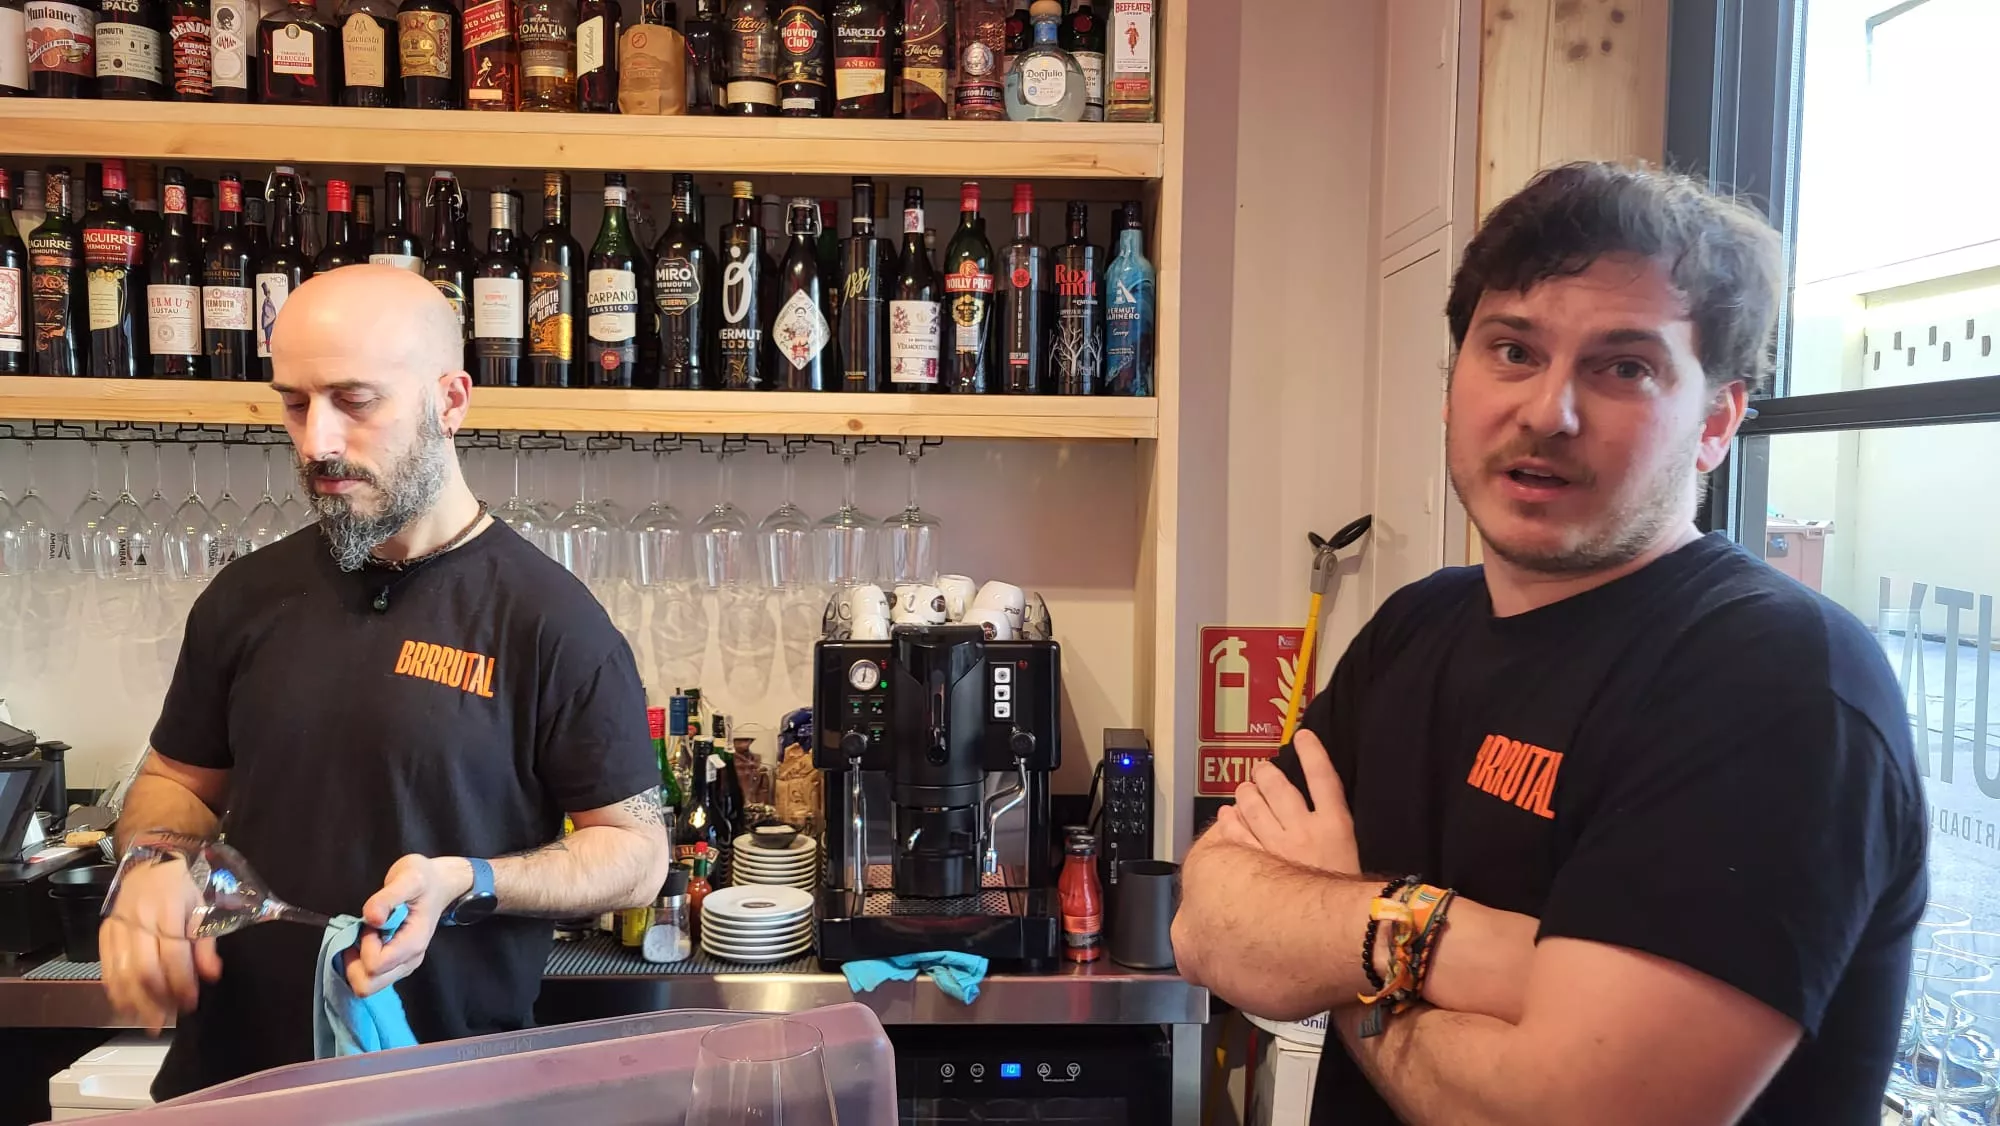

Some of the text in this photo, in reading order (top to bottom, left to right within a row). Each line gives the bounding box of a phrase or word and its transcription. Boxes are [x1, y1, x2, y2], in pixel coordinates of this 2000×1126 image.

[106, 1, 139, 13] PALO
[1115, 2, 1151, 13] BEEFEATER
[27, 6, 77, 24] Muntaner
[463, 20, 479, 30] RED
[480, 10, 506, 24] LABEL
[169, 21, 211, 40] BENDI
[519, 24, 567, 36] TOMATIN
[781, 26, 818, 38] Havana
[837, 26, 886, 37] BARCELÓ
[787, 37, 810, 48] Club
[185, 48, 208, 56] ROJO
[793, 62, 802, 74] 7
[844, 60, 876, 68] AÑEJO
[1025, 69, 1063, 80] Don Julio
[1055, 264, 1088, 284] Rox
[842, 267, 871, 310] 1884
[972, 277, 992, 289] PRAT
[1060, 280, 1097, 297] mut
[588, 290, 637, 305] CARPANO
[591, 304, 629, 314] CLASSICO
[721, 340, 756, 349] ROJO
[119, 538, 127, 567] AMBAR
[394, 640, 496, 698] BRRRUTAL
[1203, 756, 1263, 782] EXTI
[1006, 1064, 1017, 1074] 10
